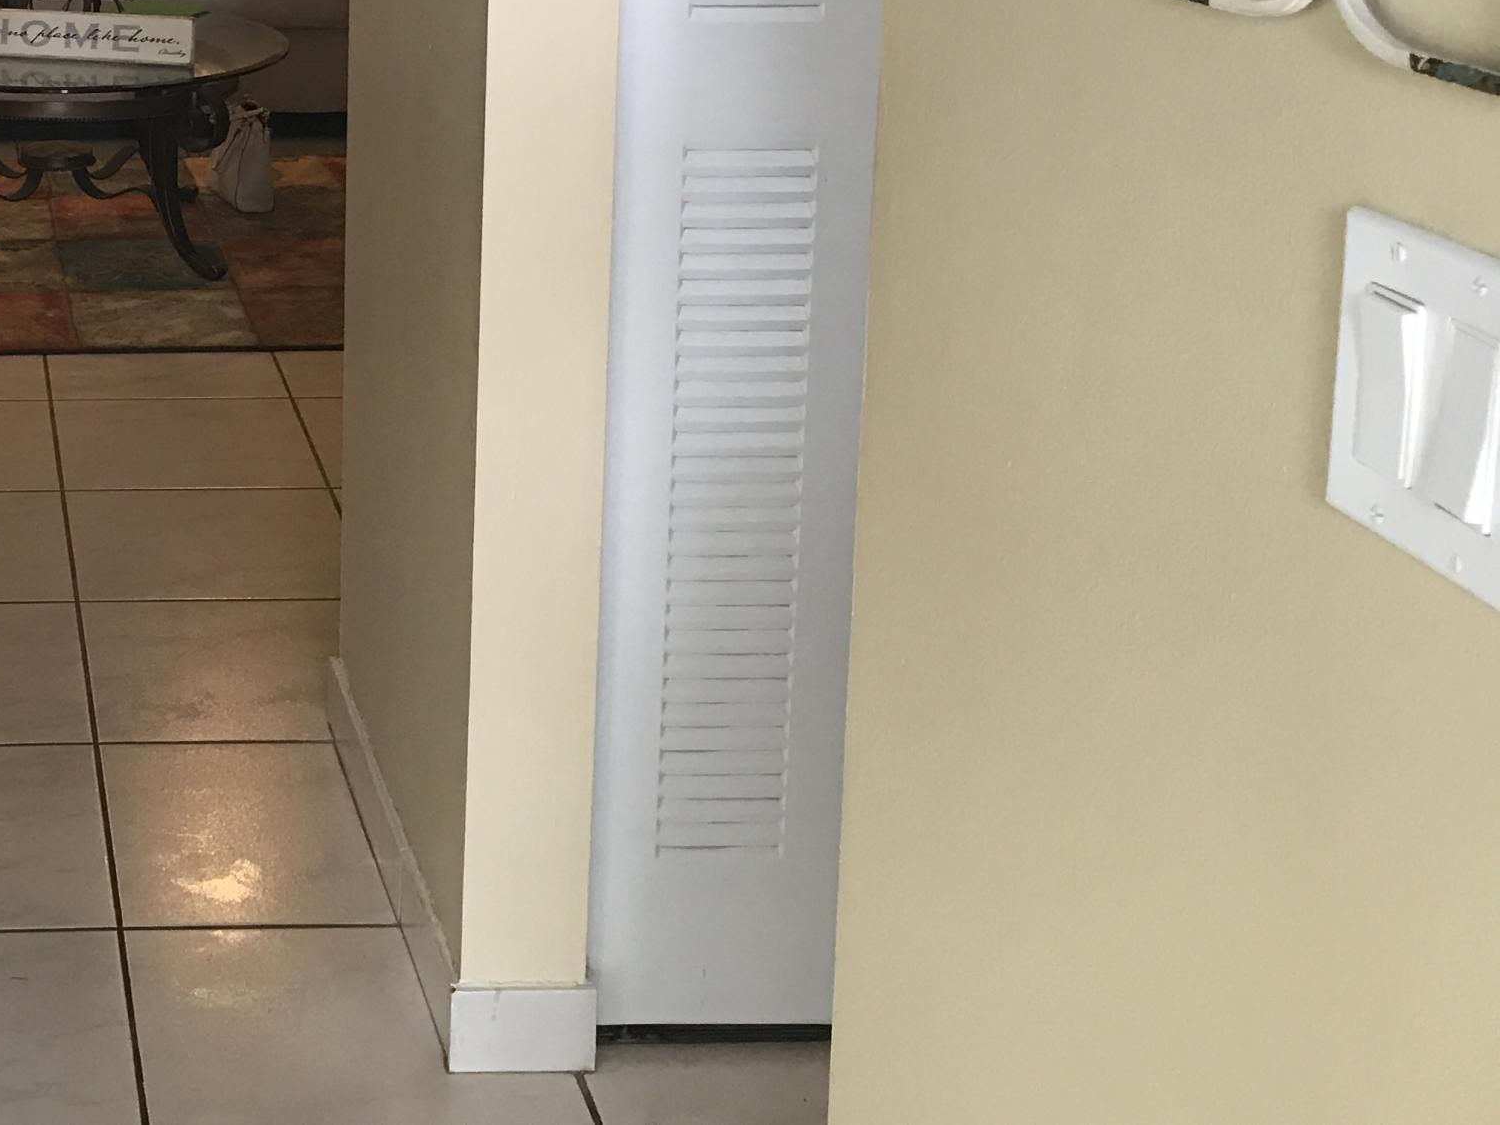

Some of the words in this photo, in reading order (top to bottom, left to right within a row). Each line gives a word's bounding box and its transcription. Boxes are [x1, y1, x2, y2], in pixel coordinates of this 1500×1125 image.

[7, 29, 28, 37] no
[29, 26, 78, 44] place
[86, 28, 120, 42] like
[127, 28, 180, 45] home.
